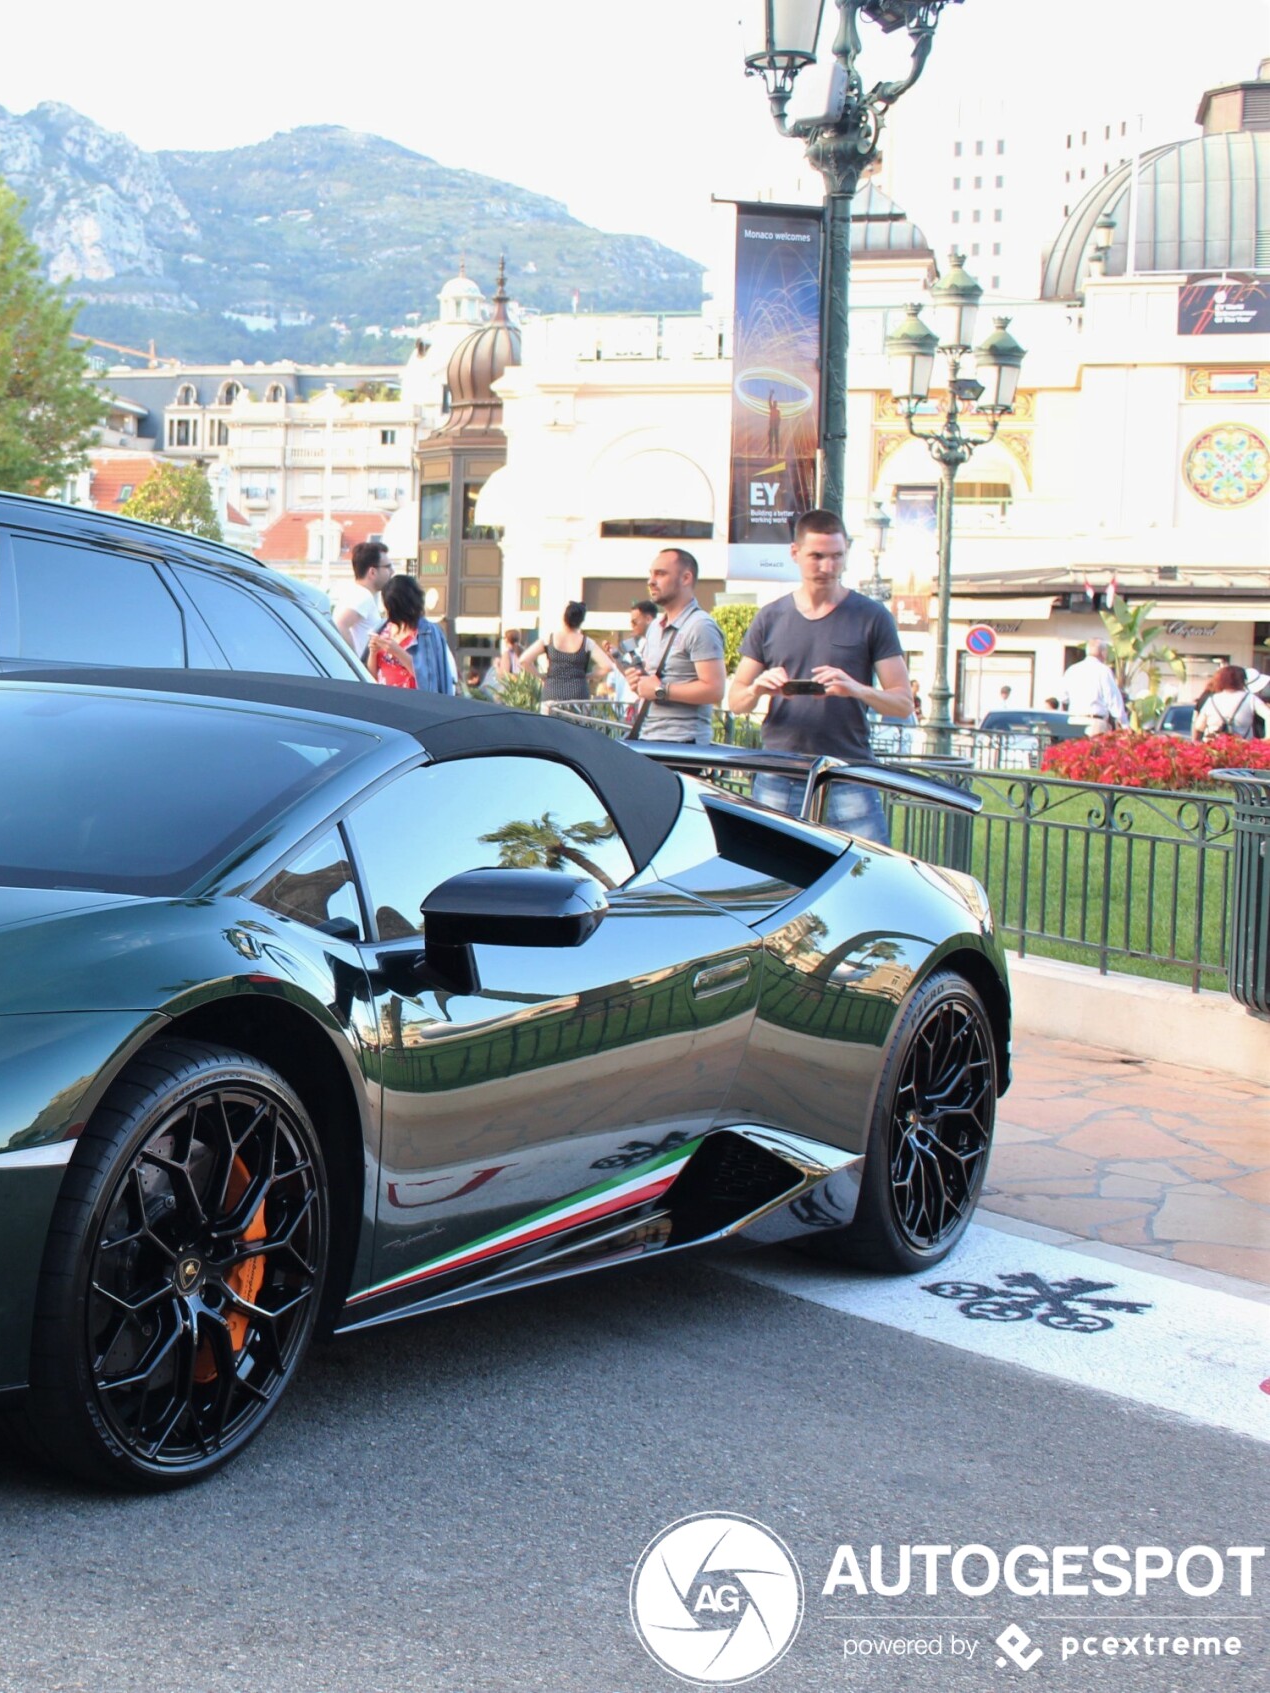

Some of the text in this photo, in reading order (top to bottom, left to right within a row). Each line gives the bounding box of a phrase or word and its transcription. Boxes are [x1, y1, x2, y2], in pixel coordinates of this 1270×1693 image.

[744, 229, 811, 242] Monaco welcomes
[750, 482, 780, 506] EY
[750, 509, 772, 518] Building
